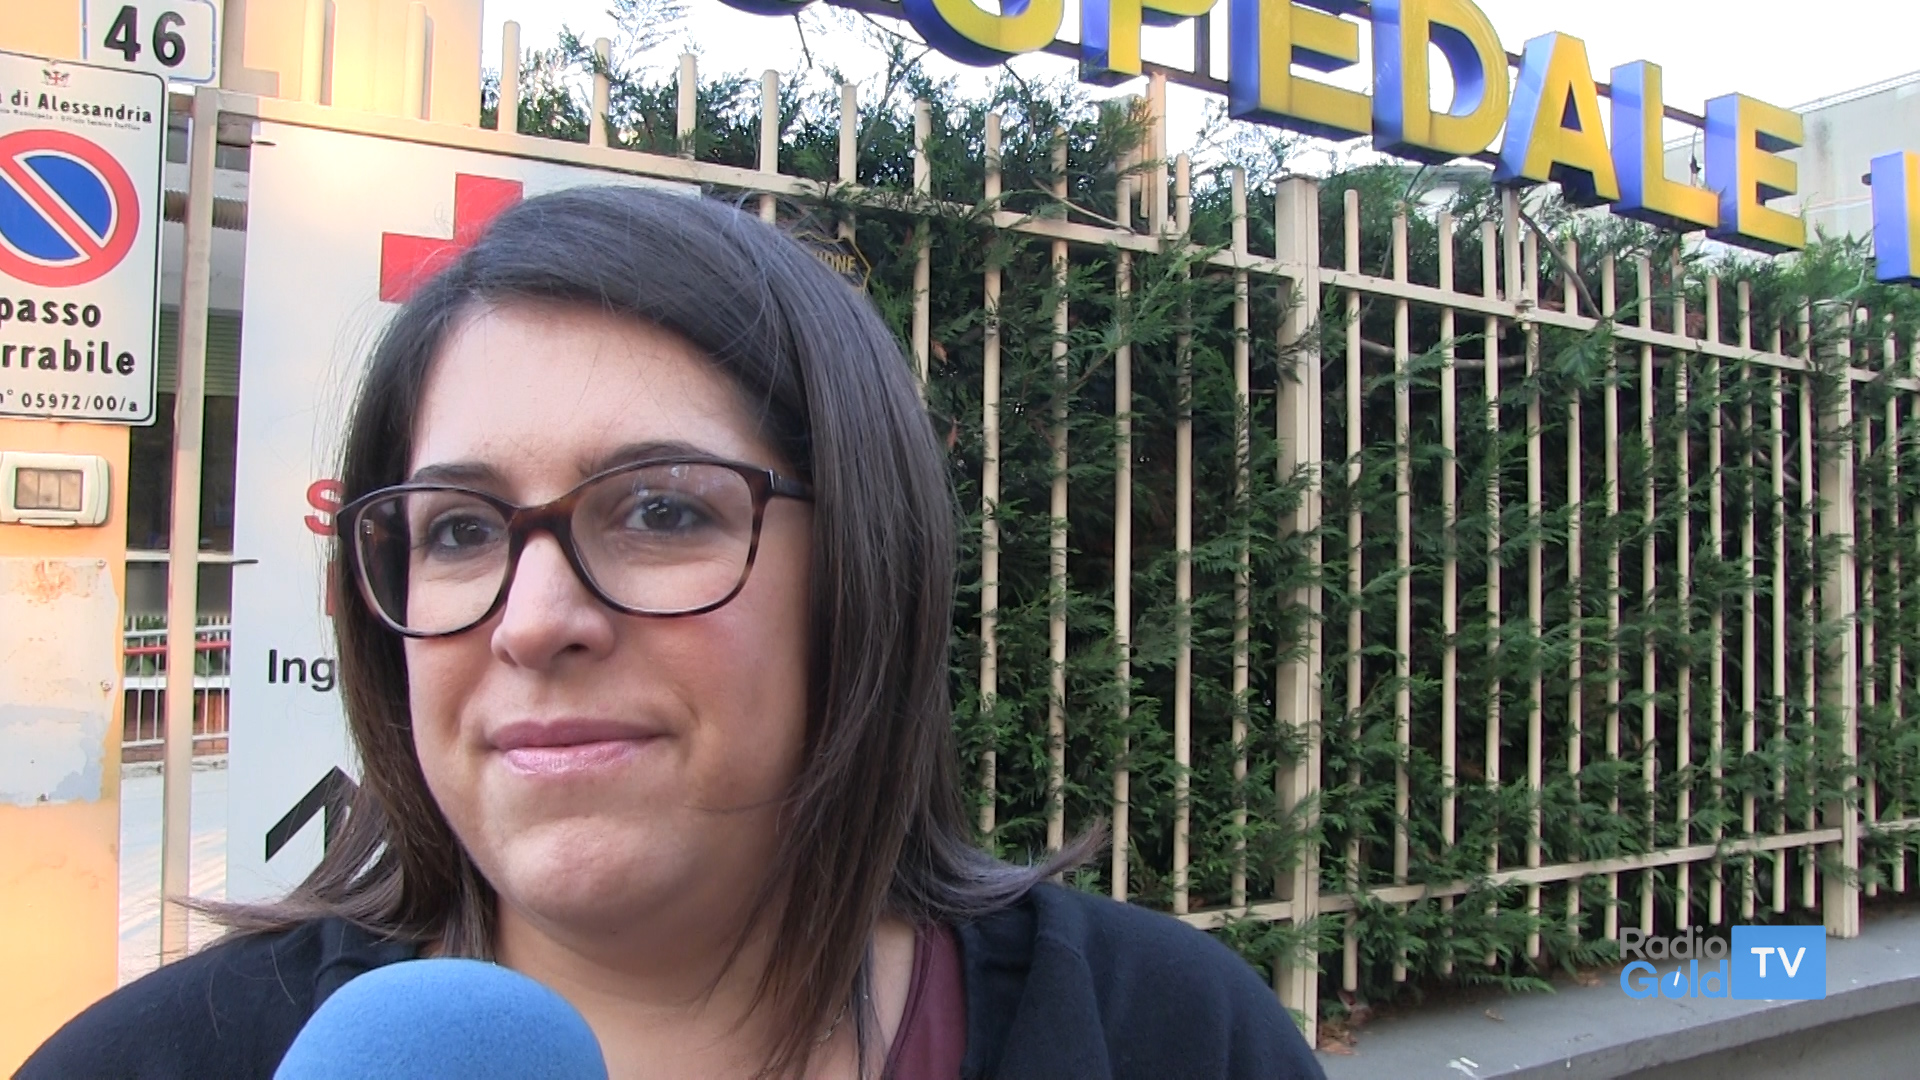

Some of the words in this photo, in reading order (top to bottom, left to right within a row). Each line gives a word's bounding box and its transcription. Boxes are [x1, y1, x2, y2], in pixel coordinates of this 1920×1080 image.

[104, 5, 186, 67] 46
[11, 90, 29, 107] di
[38, 93, 152, 124] Alessandria
[715, 0, 1806, 253] EDALE
[0, 296, 102, 329] passo
